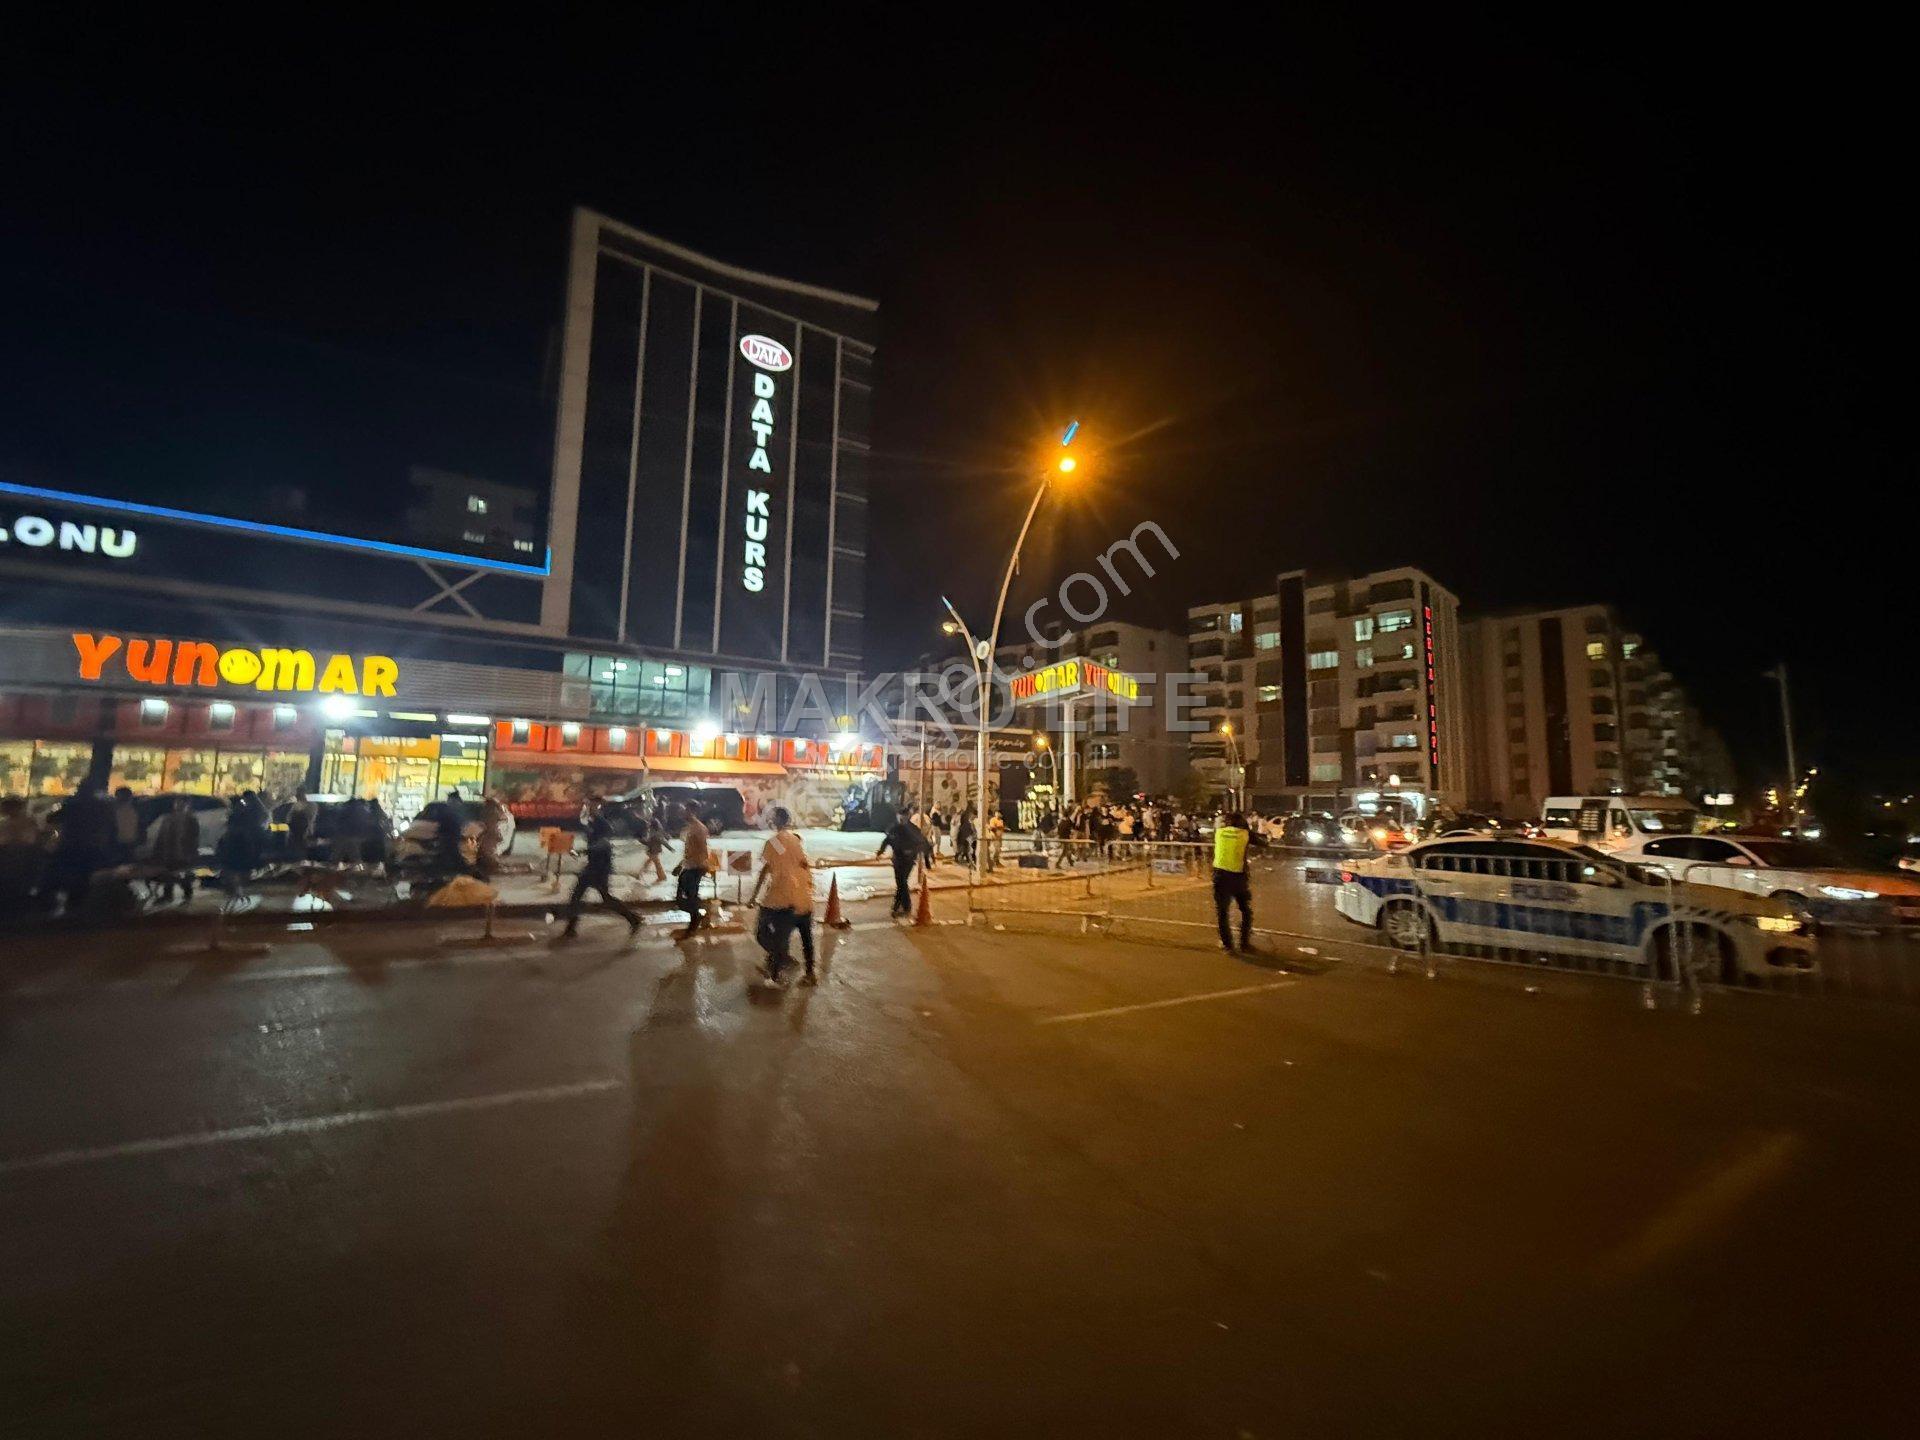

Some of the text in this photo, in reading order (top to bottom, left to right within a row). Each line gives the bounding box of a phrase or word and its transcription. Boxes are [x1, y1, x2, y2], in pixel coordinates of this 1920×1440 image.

[749, 339, 783, 367] DATA
[743, 372, 775, 592] DATA KURS
[0, 515, 137, 558] ONU
